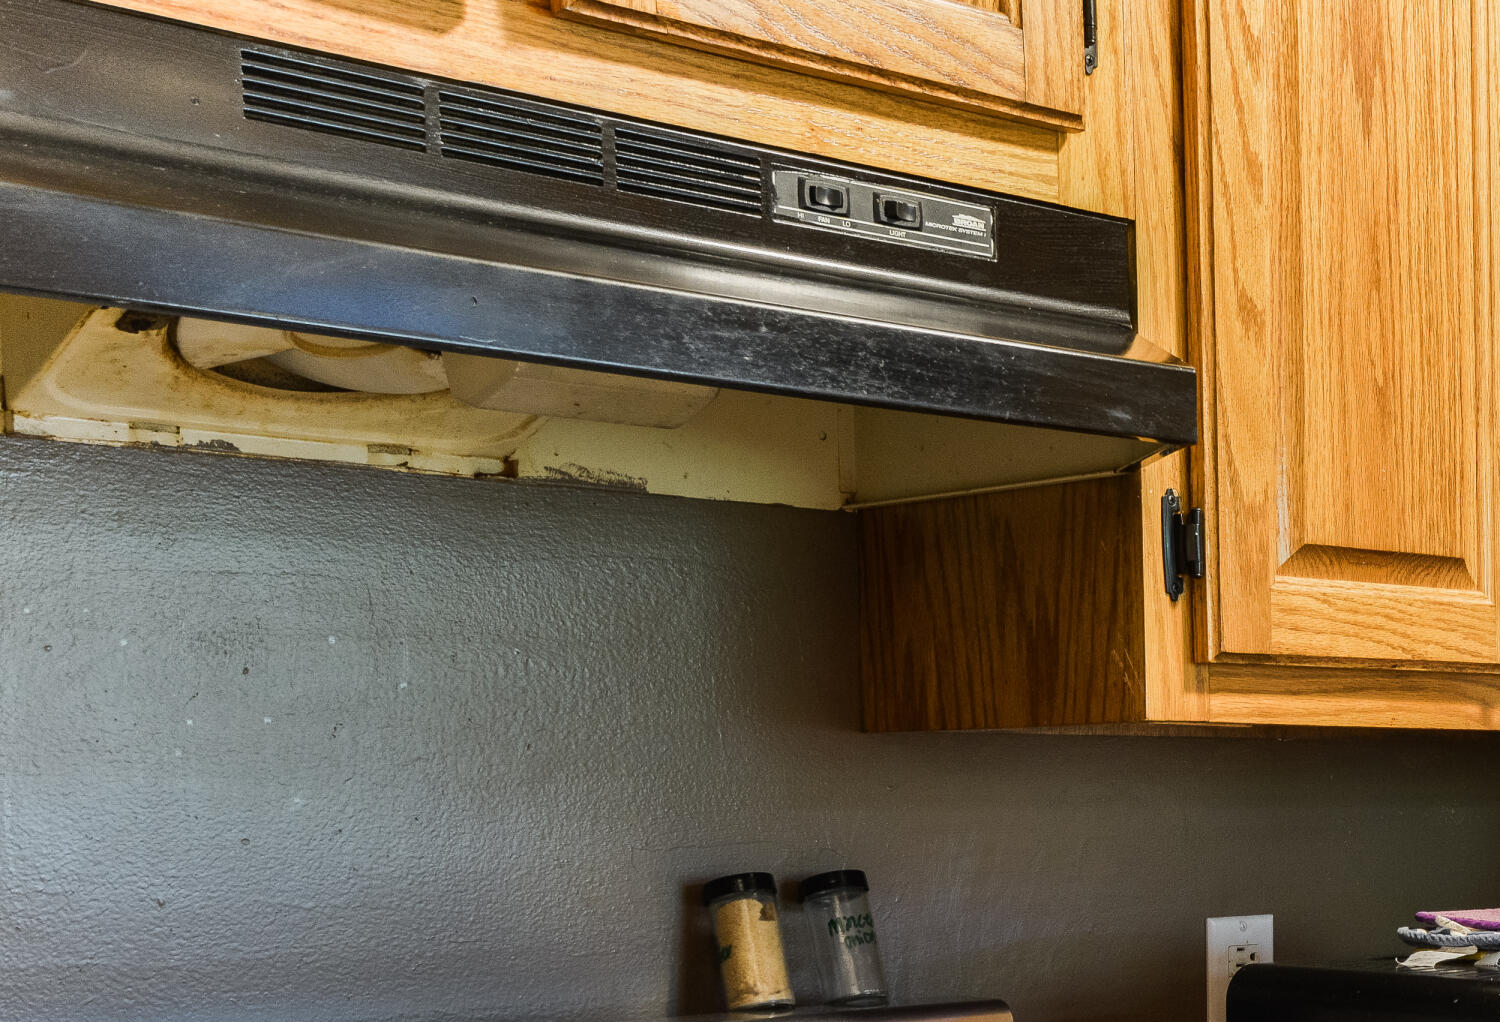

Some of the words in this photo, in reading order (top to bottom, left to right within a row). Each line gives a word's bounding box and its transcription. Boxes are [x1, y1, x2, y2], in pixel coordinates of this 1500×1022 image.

[818, 216, 831, 224] FAN
[889, 229, 906, 238] LIGHT
[958, 227, 983, 237] SYSTEM
